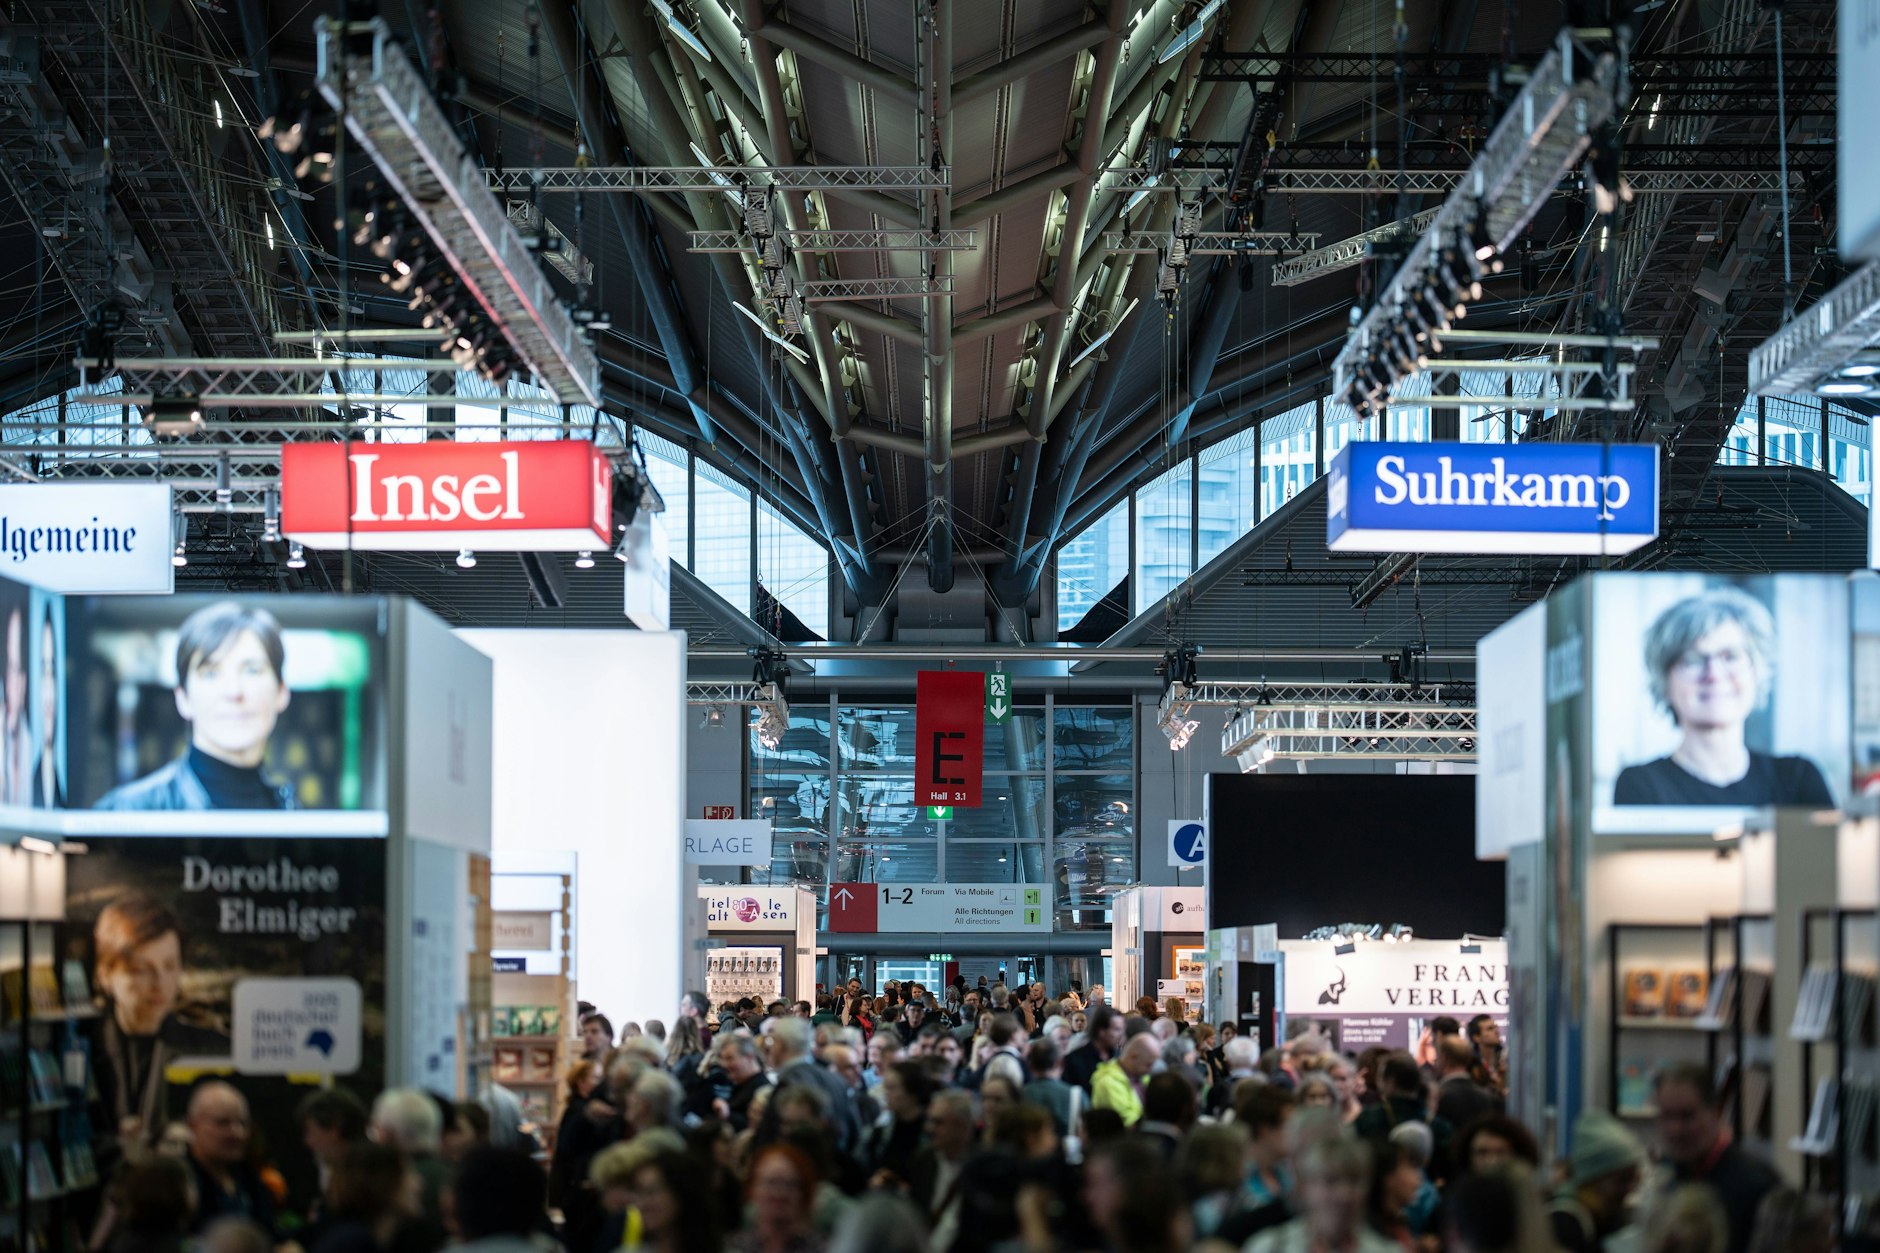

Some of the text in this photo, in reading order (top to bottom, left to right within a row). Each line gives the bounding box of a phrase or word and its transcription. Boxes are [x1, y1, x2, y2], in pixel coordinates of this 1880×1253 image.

[349, 451, 525, 522] Insel
[1374, 455, 1631, 521] Suhrkamp
[932, 731, 966, 785] E
[930, 792, 967, 801] Hall 3.1
[182, 856, 340, 893] Dorothee
[921, 888, 945, 896] Forum
[954, 888, 966, 896] Via
[968, 888, 995, 896] Mobile
[769, 898, 782, 911] le
[1186, 904, 1205, 912] aufb
[762, 911, 788, 920] sen
[954, 908, 1014, 917] Alle Richtungen
[218, 898, 357, 942] Elmiger
[954, 917, 1001, 925] All directions
